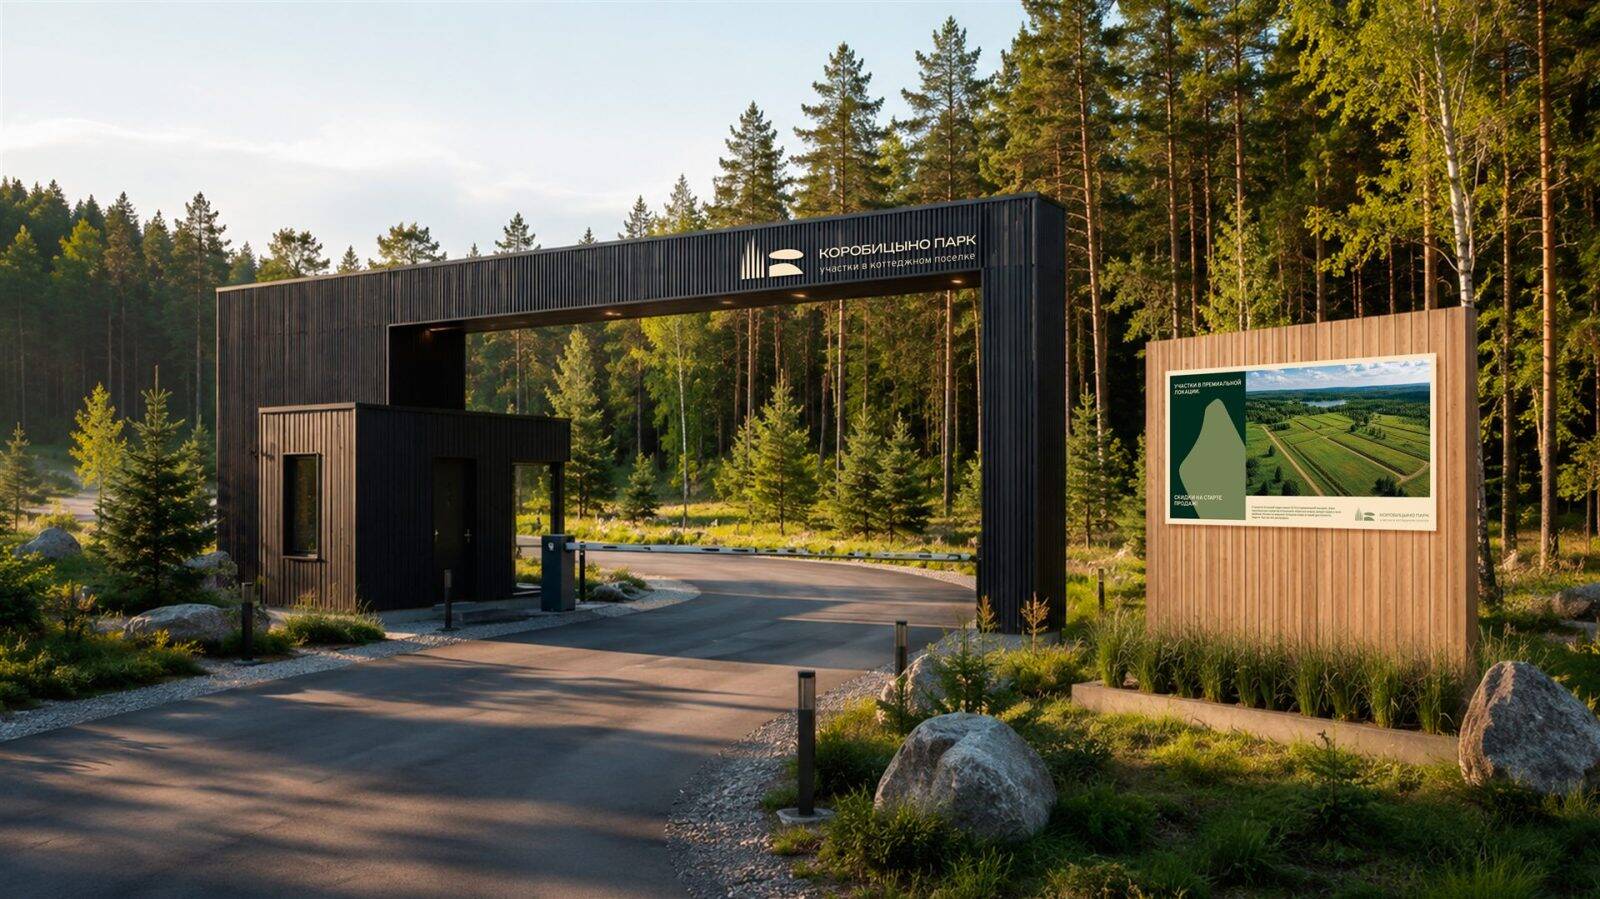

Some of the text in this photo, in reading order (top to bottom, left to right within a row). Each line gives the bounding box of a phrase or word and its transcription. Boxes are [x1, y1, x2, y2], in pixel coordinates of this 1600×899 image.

[819, 234, 977, 259] КОРОБИЦЫНО ПАРК
[819, 263, 859, 275] участки
[870, 257, 932, 269] коттеджном
[934, 252, 976, 264] поселке
